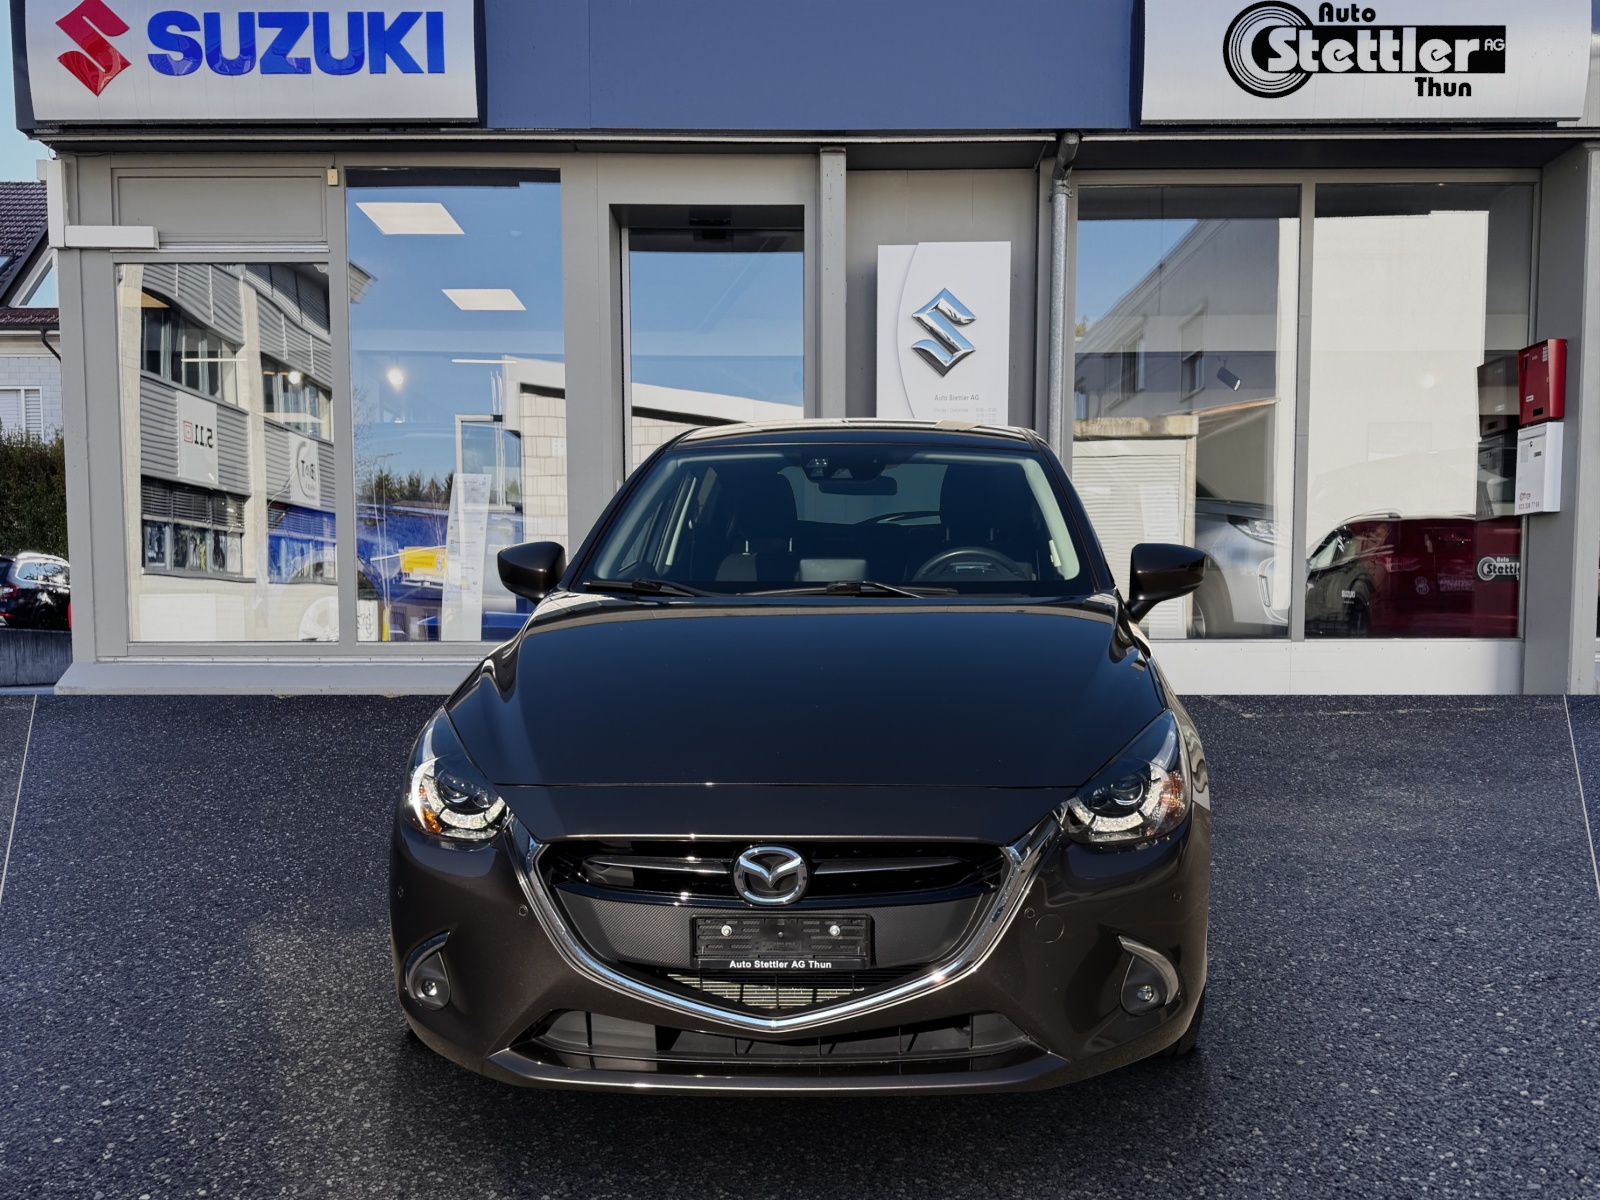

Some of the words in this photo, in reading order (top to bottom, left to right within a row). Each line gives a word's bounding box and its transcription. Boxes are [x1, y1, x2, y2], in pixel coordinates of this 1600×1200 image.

[1318, 2, 1377, 23] Auto
[147, 11, 446, 76] SUZUKI
[1267, 27, 1481, 73] Stettler
[1484, 38, 1505, 52] AG
[1414, 76, 1472, 97] Thun
[729, 960, 752, 969] Auto
[753, 960, 789, 969] Stettler
[791, 960, 806, 969] AG
[808, 960, 832, 969] Thun
